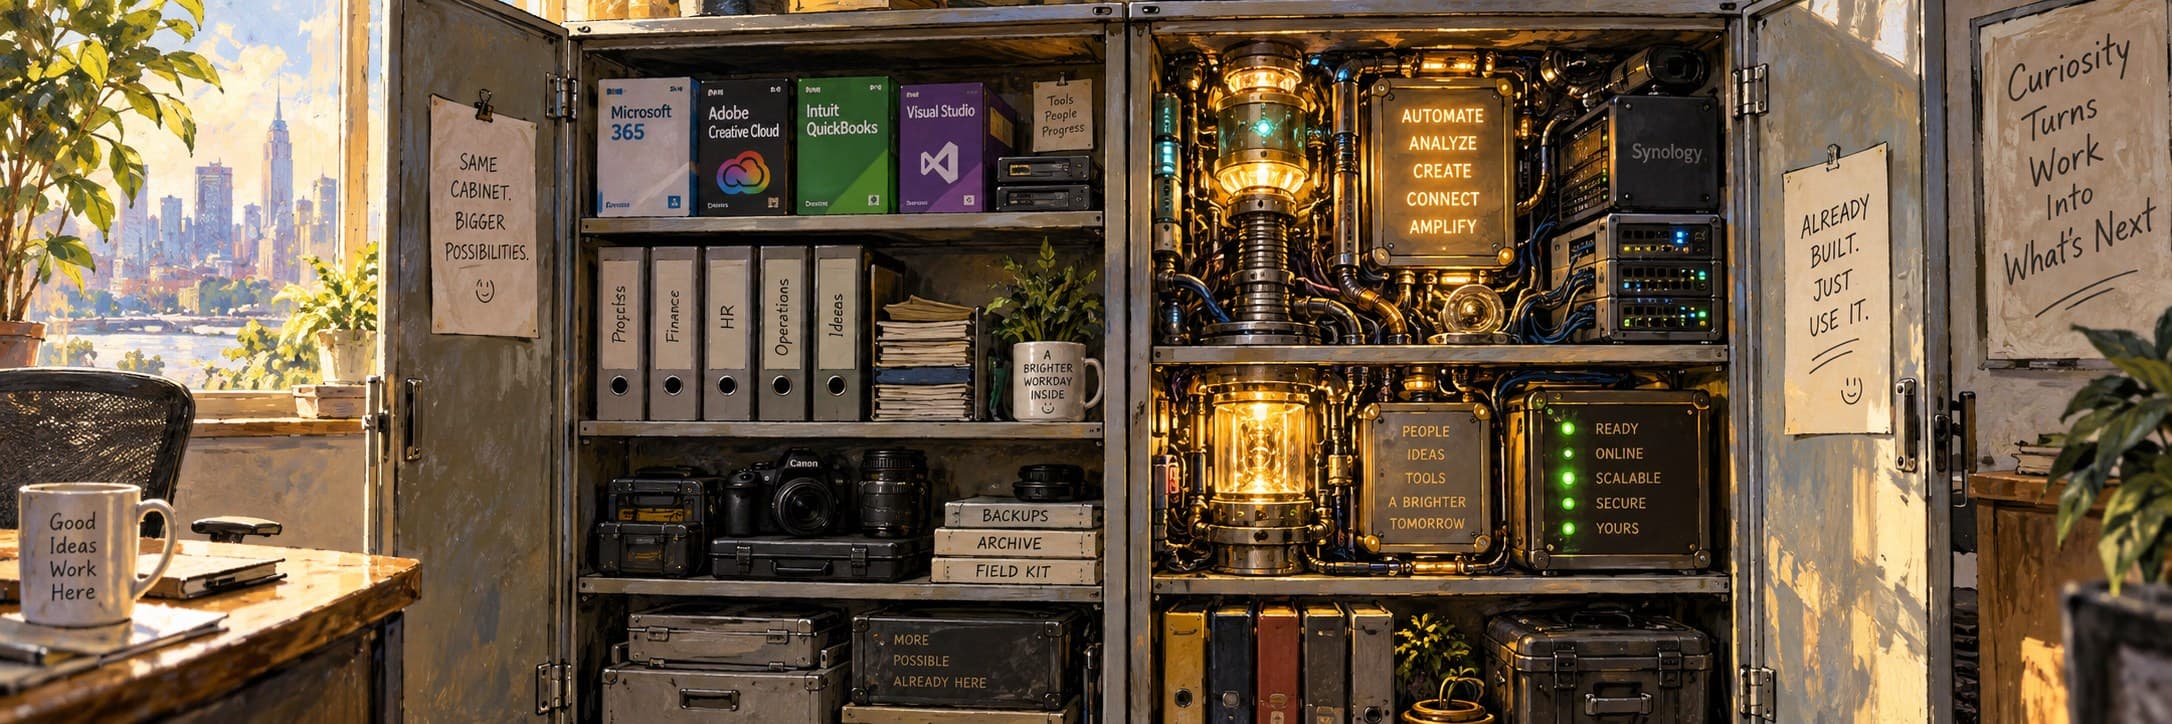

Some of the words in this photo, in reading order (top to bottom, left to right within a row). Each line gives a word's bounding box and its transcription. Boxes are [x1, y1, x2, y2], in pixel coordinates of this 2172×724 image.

[2008, 34, 2130, 102] Curiosity
[1046, 94, 1074, 106] Tools
[612, 104, 672, 120] Microsoft
[708, 104, 748, 120] Adobe
[806, 104, 840, 118] Intuit
[906, 104, 938, 118] Visual
[940, 104, 976, 118] Studio
[1044, 108, 1078, 122] People
[1402, 108, 1484, 124] AUTOMATE
[2020, 97, 2098, 142] Turns
[612, 124, 644, 140] 365
[708, 124, 748, 138] Creative
[750, 122, 780, 138] Cloud
[806, 120, 878, 138] QuickBooks
[1042, 120, 1084, 138] Progress
[1408, 136, 1476, 150] ANALYZE
[1632, 142, 1702, 164] Synology
[2030, 132, 2104, 188] Work
[460, 152, 498, 172] SAME
[1414, 164, 1472, 178] CREATE
[450, 180, 512, 200] CABINET.
[1406, 192, 1480, 206] CONNECT
[2048, 184, 2093, 221] Into
[456, 210, 506, 230] BIGGER
[1801, 194, 1869, 240] ALREADY
[1410, 218, 1476, 234] AMPLIFY
[2004, 226, 2082, 286] What's
[2096, 196, 2156, 252] Next
[446, 242, 528, 262] POSSIBILITIES.
[1810, 232, 1858, 268] BUILT.
[1812, 268, 1852, 301] JUST
[666, 290, 680, 342] Finance
[720, 306, 734, 328] HR
[774, 278, 792, 356] Operations
[1810, 308, 1838, 336] USE
[1850, 298, 1868, 324] IT.
[1044, 350, 1052, 360] A
[1024, 360, 1074, 376] BRIGHTER
[1024, 374, 1074, 388] WORKDAY
[1032, 390, 1064, 400] INSIDE
[1402, 426, 1450, 438] PEOPLE
[1596, 422, 1638, 434] READY
[1408, 448, 1444, 460] IDEAS
[1596, 448, 1644, 460] ONLINE
[790, 460, 818, 468] Canon
[1404, 472, 1446, 484] TOOLS
[1596, 472, 1660, 484] SCALABLE
[1388, 496, 1398, 508] A
[1404, 496, 1466, 508] BRIGHTER
[1596, 498, 1646, 510] SECURE
[50, 512, 96, 532] Good
[982, 508, 1048, 522] BACKUPS
[1390, 518, 1464, 530] TOMORROW
[1596, 522, 1638, 534] YOURS
[50, 536, 96, 554] Ideas
[976, 536, 1042, 550] ARCHIVE
[50, 560, 96, 578] Work
[976, 564, 1018, 578] FIELD
[1026, 566, 1052, 578] KIT
[52, 584, 96, 602] Here
[894, 634, 928, 646] MORE
[894, 654, 950, 666] POSSIBLE
[894, 676, 948, 688] ALREADY
[954, 676, 986, 688] HERE
